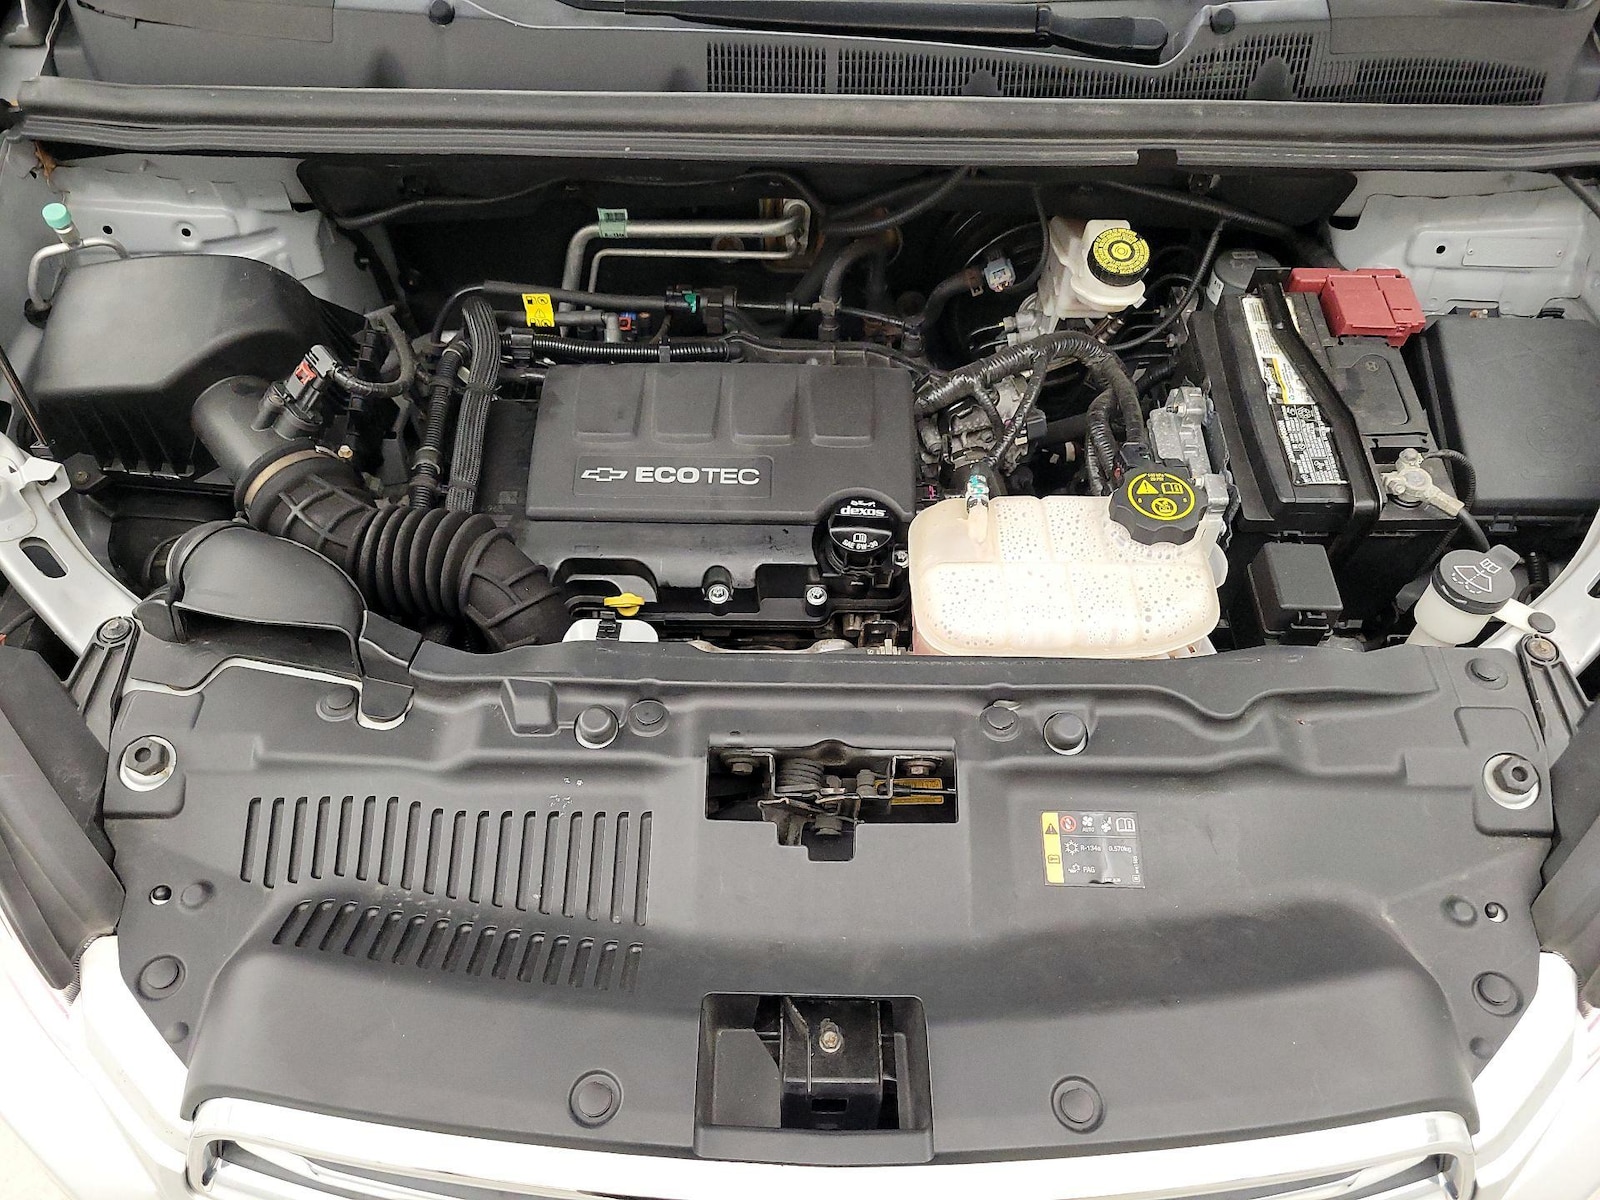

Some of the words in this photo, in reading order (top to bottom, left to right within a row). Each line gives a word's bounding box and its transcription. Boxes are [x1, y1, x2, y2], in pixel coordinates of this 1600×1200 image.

[635, 466, 760, 485] ECOTEC
[840, 505, 887, 516] dexos
[842, 539, 855, 549] SAE
